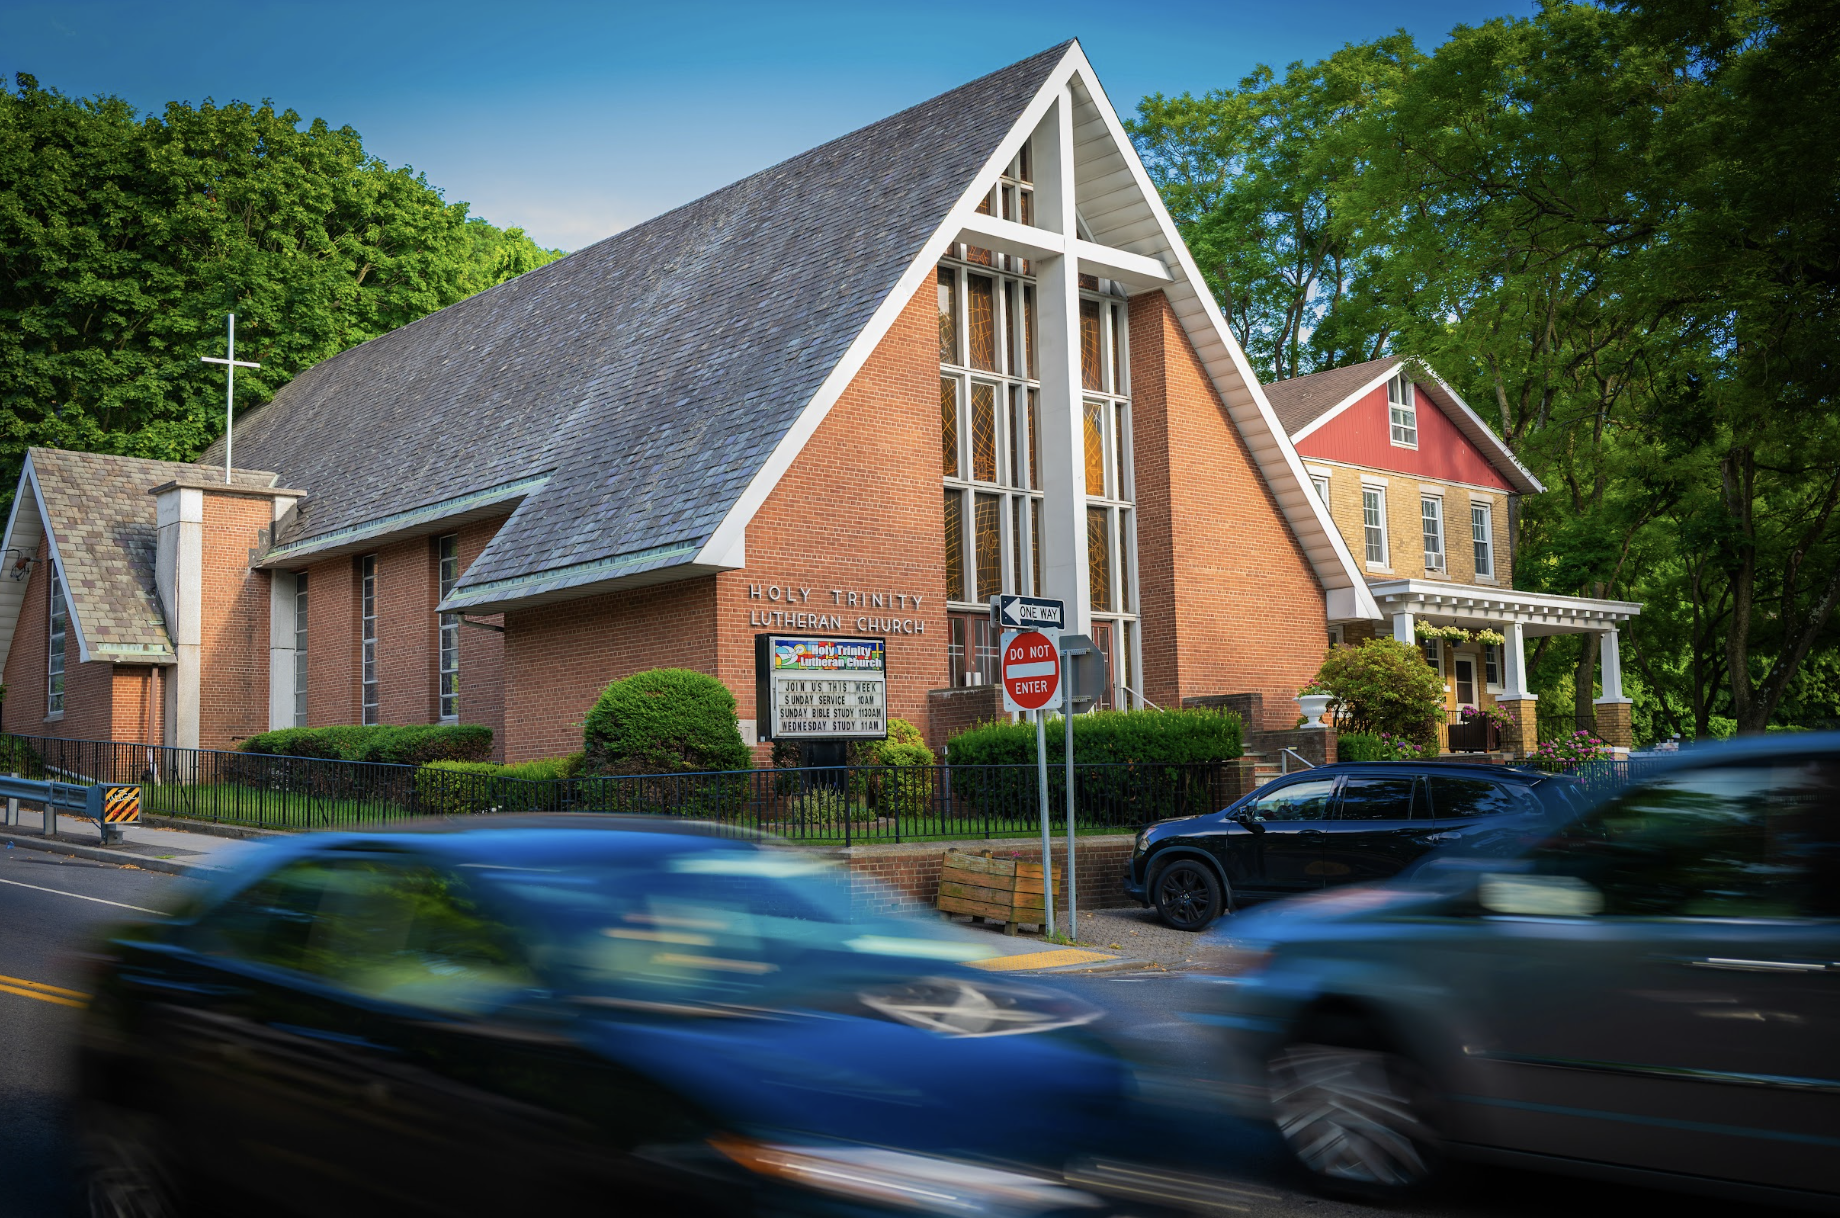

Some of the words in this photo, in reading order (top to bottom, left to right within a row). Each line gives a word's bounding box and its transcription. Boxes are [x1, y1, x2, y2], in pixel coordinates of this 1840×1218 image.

[749, 583, 811, 603] HOLY
[832, 589, 923, 610] TRINITY
[1020, 605, 1038, 619] ONE
[1039, 607, 1058, 620] WAY
[750, 610, 841, 630] LUTHERAN
[857, 616, 925, 634] CHURCH
[811, 644, 835, 657] Holy
[836, 645, 872, 657] Trinity
[1010, 647, 1024, 661] DO
[1029, 645, 1050, 659] NOT
[800, 656, 845, 667] Lutheran
[846, 657, 882, 667] Church
[785, 682, 805, 692] JOIN
[811, 682, 822, 692] US
[828, 682, 847, 692] THIS
[855, 682, 876, 692] WEEK
[1015, 680, 1048, 695] ENTER
[784, 695, 814, 705] SUNDAY
[818, 695, 846, 705] SERVICE
[857, 695, 874, 705] 10AM
[780, 708, 808, 718] SUNDAY
[812, 708, 830, 718] BIBLE
[833, 708, 854, 718] STUDY
[858, 708, 881, 718] 1130AM
[781, 721, 827, 731] WEDNESDAY
[832, 721, 856, 731] STUDY
[861, 721, 879, 731] 11AM
